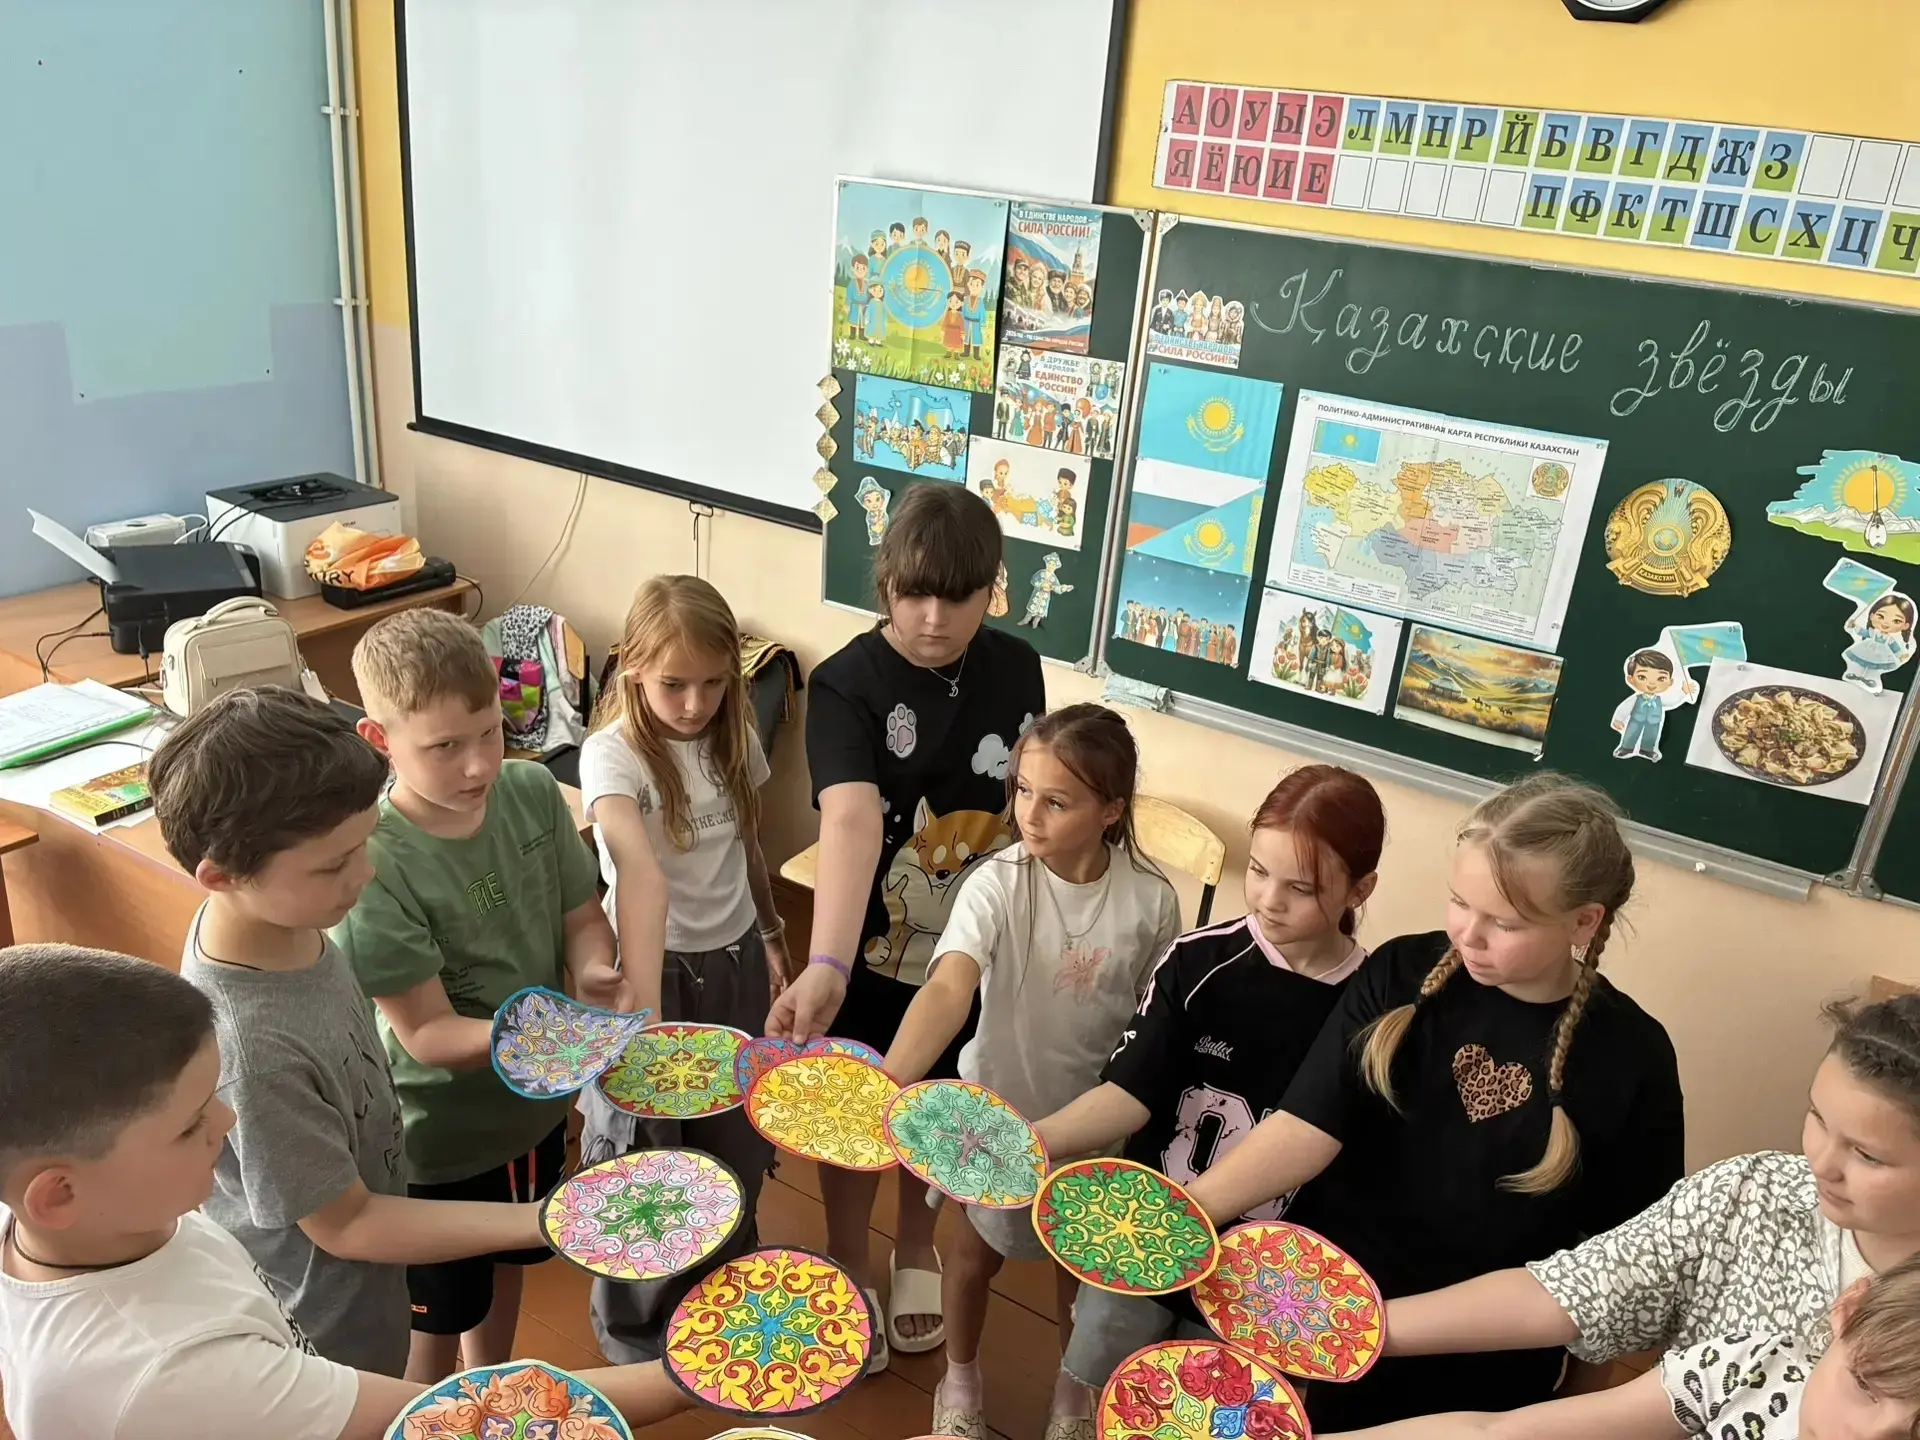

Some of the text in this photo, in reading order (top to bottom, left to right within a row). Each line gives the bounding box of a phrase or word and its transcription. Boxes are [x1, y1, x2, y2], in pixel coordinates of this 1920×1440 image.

[1174, 95, 1792, 180] А О У Ы Э Л М Н Р Й Б В Г Д Ж З
[1170, 147, 1920, 264] Я Ё Ю И Е П Ф К Т Ш С Х Ц Ч
[1024, 212, 1056, 221] ЕДИНСТВЕ
[1057, 214, 1088, 223] НАРОДОВ
[1018, 221, 1091, 238] СИЛА РОССИИ!
[1047, 356, 1080, 367] ДРУЖБЕ
[1158, 344, 1229, 364] СИЛА РОССИИ!
[1035, 371, 1084, 385] ЕДИНСТВО
[1610, 319, 1854, 433] звёзды
[1039, 382, 1077, 395] РОССИИ!
[1318, 404, 1580, 457] ПОЛИТИКО-АДМИНИСТРАТИВНАЯ КАРТА РЕСПУБЛИКИ КАЗАХСТАН
[1199, 1034, 1234, 1055] Ballet
